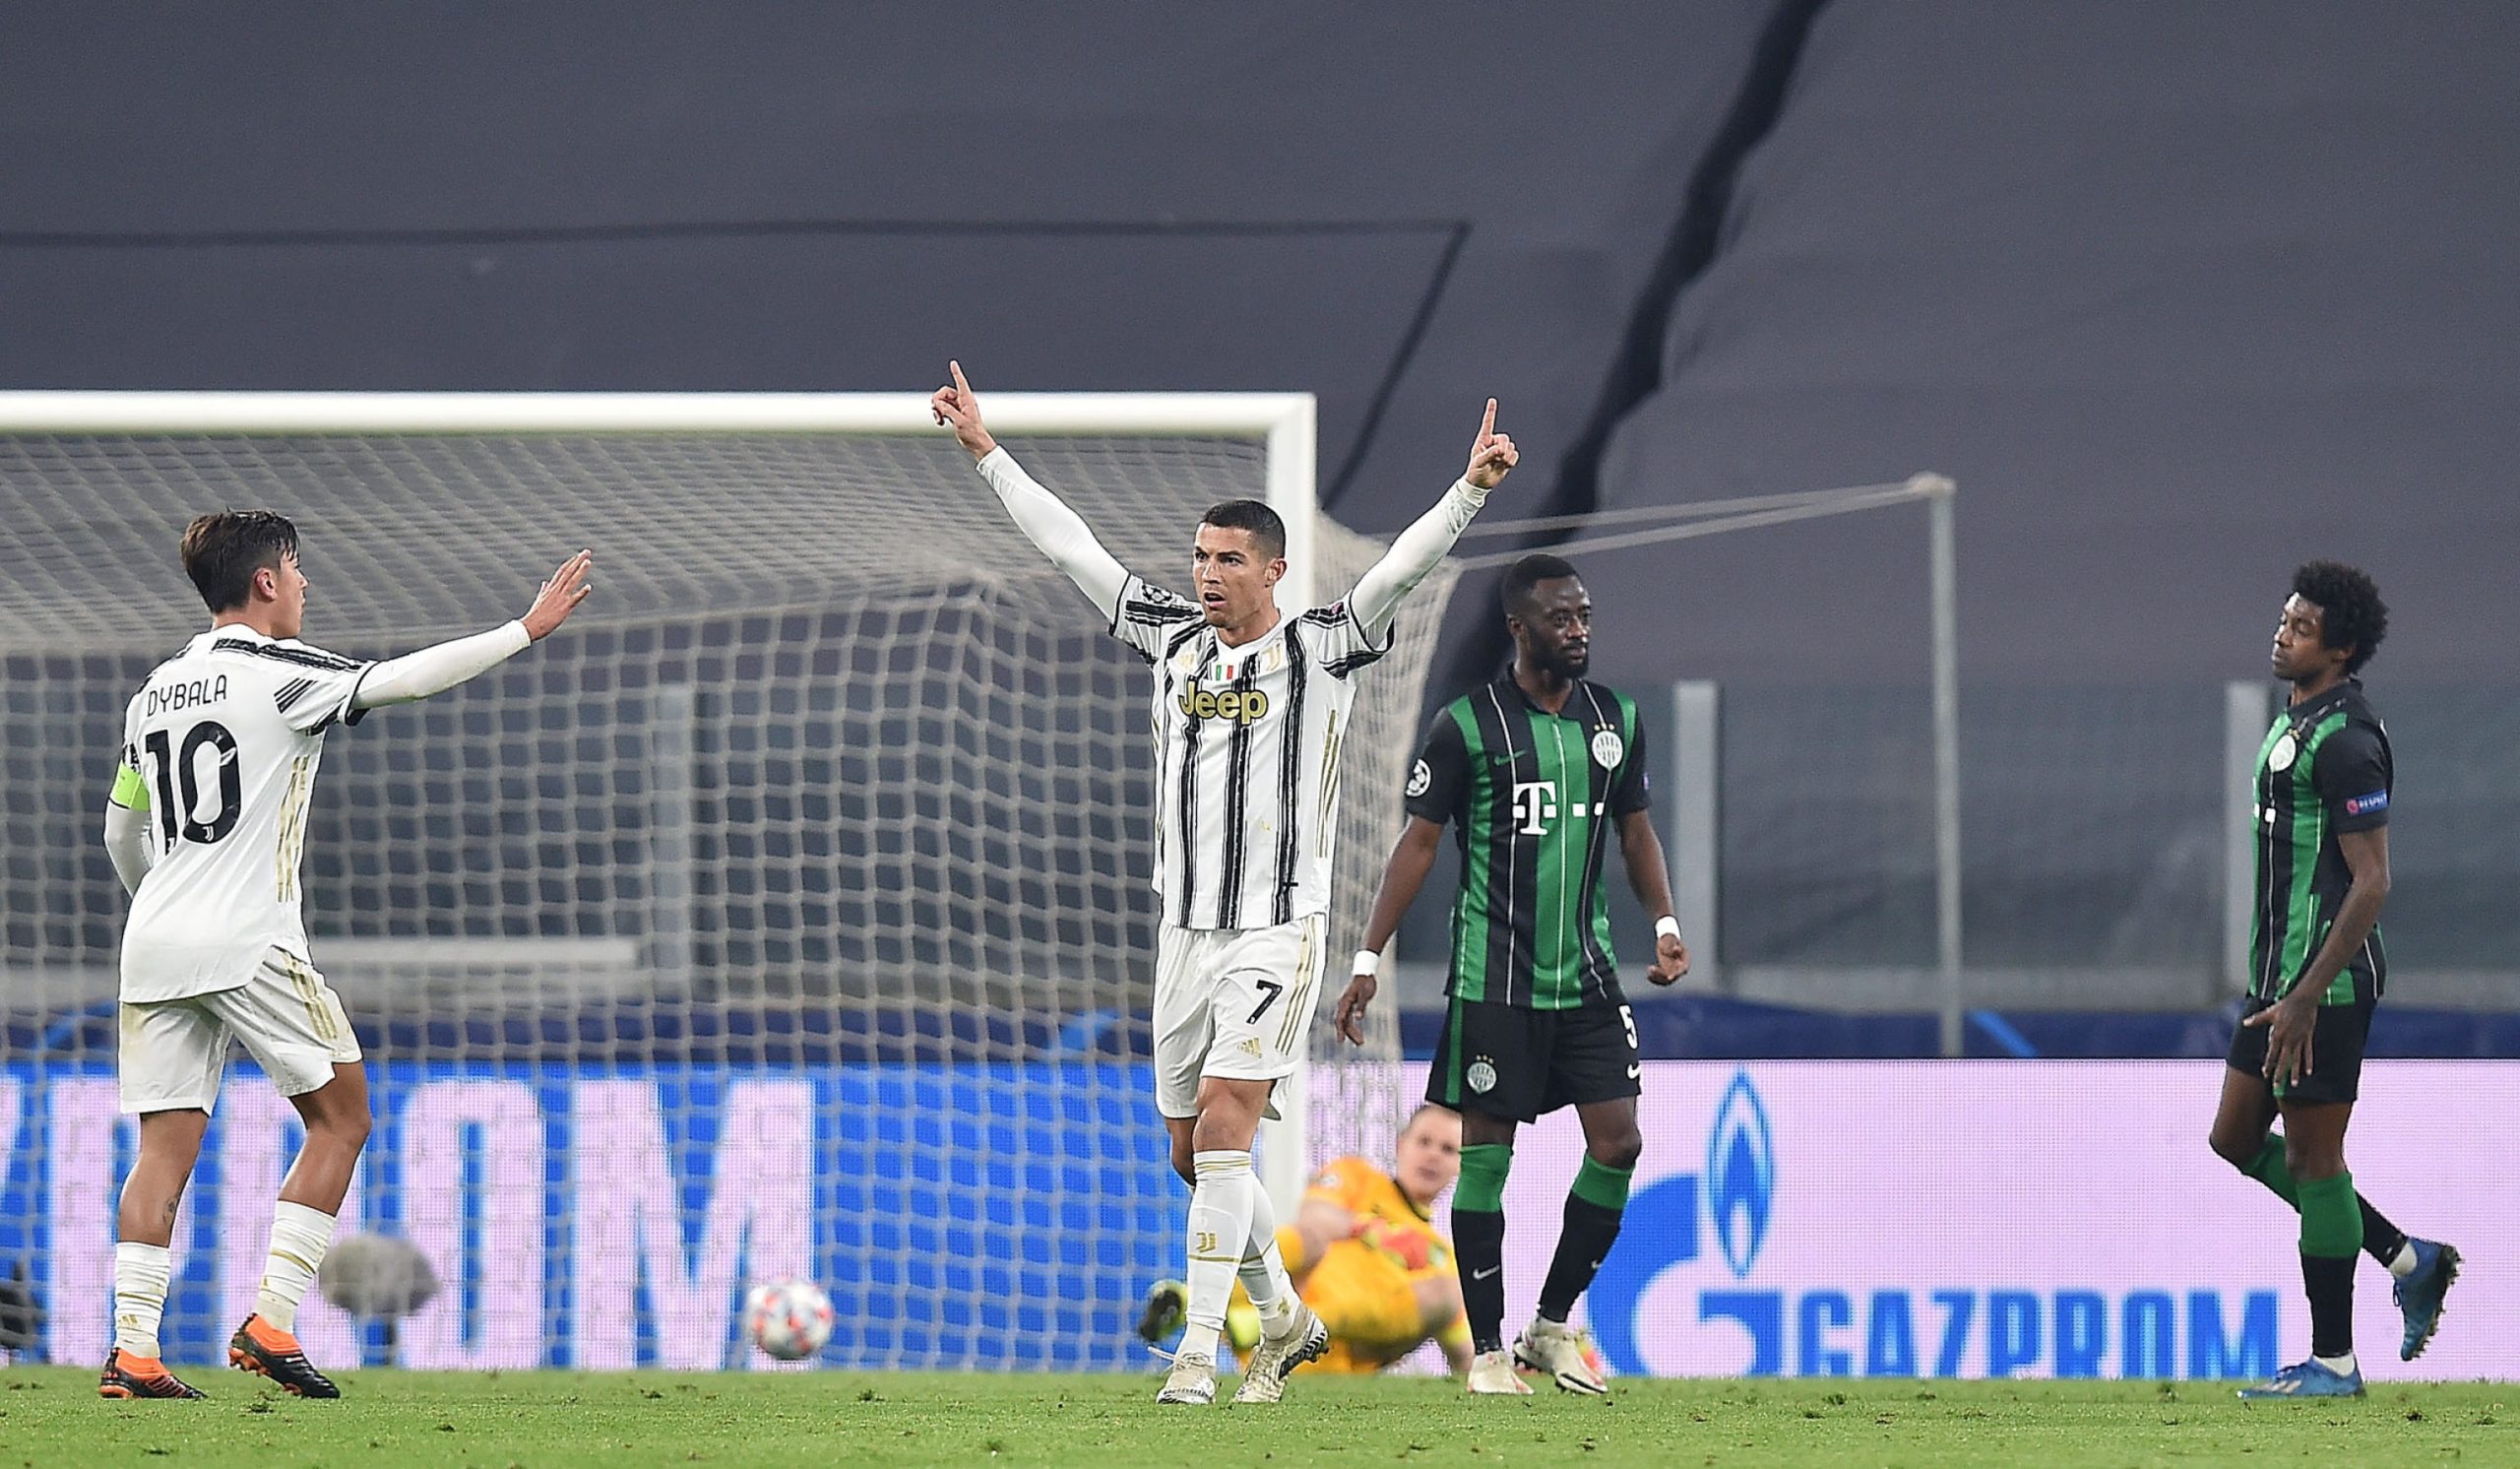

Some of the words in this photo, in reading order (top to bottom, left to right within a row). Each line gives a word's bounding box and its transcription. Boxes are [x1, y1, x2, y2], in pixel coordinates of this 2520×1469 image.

[147, 674, 227, 717] DYBALA
[1177, 675, 1269, 726] Jeep
[145, 720, 241, 856] 10
[1246, 979, 1283, 1025] 7
[1617, 1004, 1638, 1050] 5
[0, 1075, 820, 1371] PROM
[1796, 1290, 2280, 1377] GAZPROM
